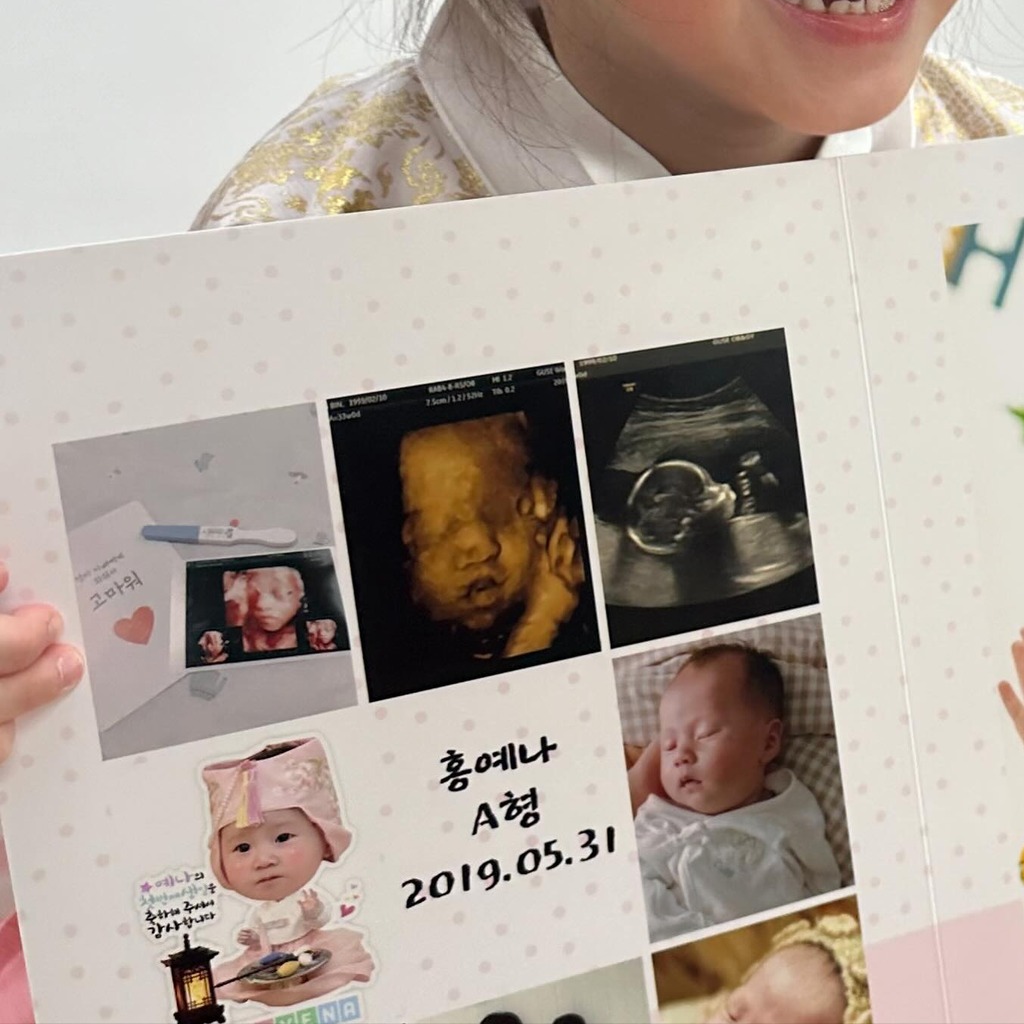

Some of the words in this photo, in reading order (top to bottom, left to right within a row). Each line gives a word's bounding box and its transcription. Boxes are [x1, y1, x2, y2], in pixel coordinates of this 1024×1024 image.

[89, 570, 144, 612] 고마워
[440, 735, 558, 792] 홍예나
[471, 787, 540, 836] A형
[401, 826, 616, 909] 2019.05.31
[147, 911, 216, 939] 감사합니다
